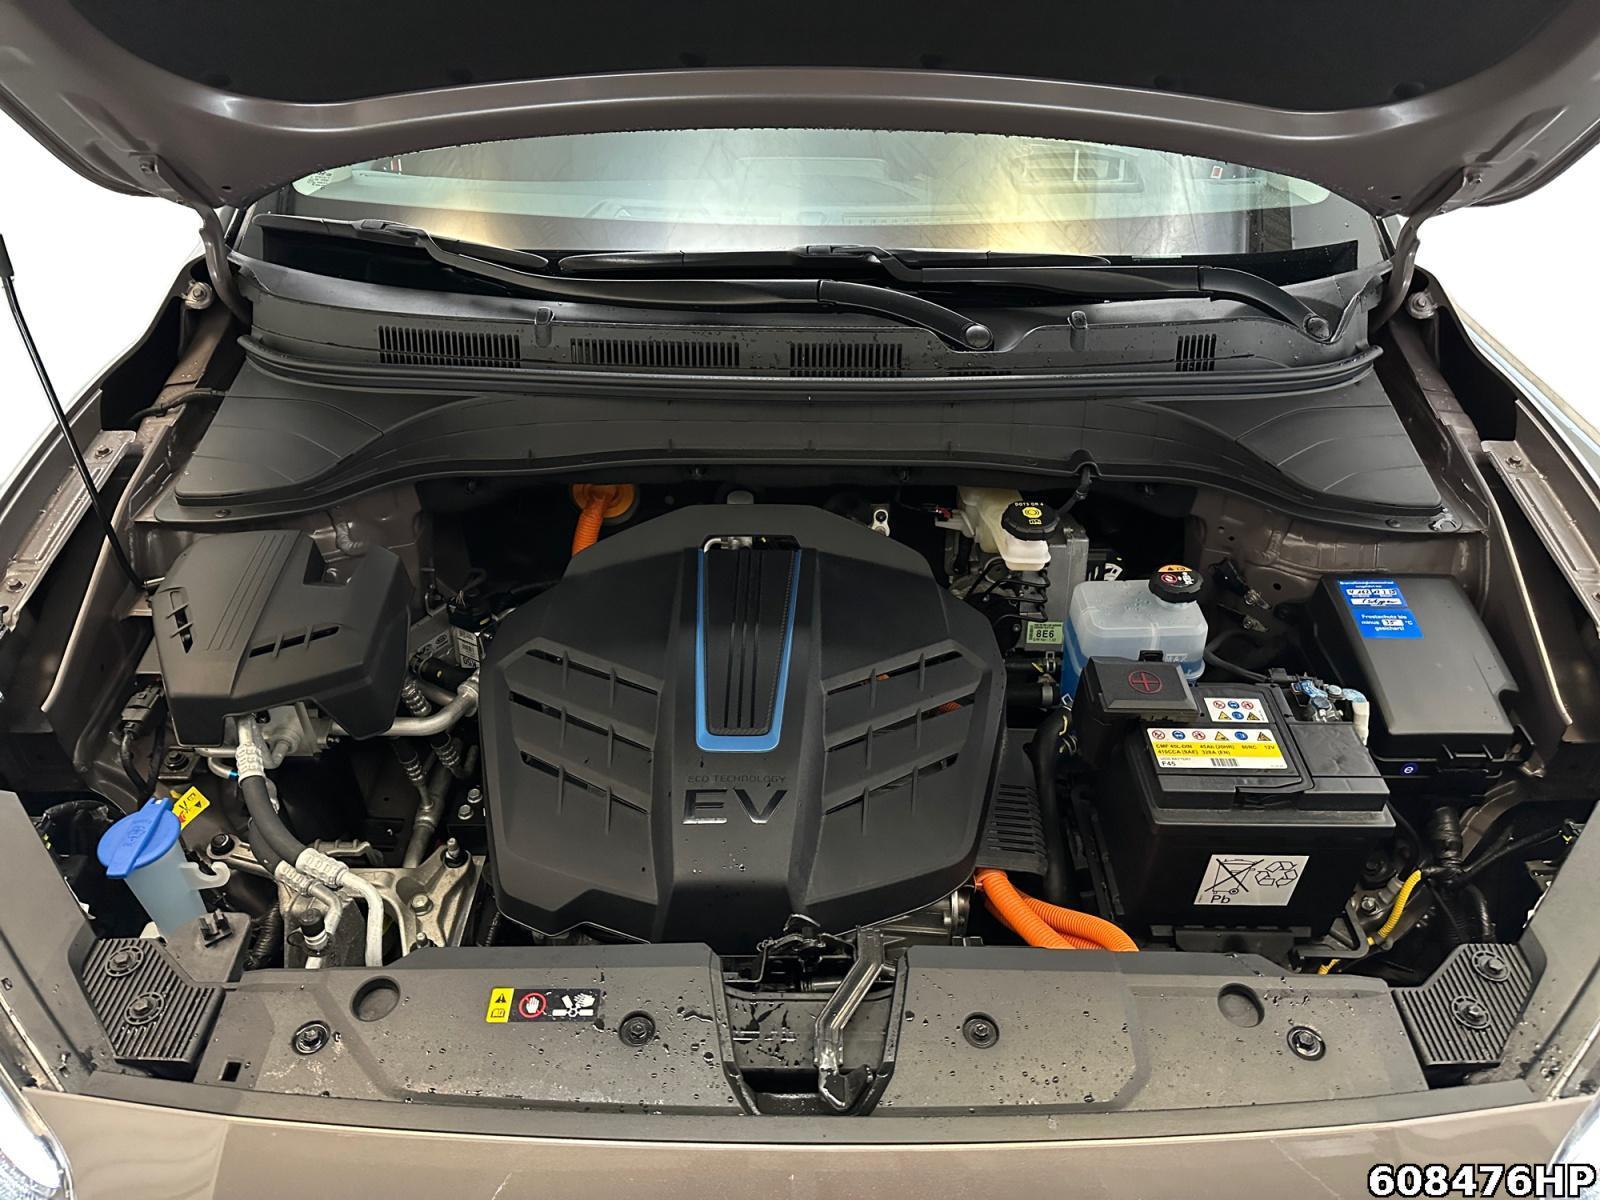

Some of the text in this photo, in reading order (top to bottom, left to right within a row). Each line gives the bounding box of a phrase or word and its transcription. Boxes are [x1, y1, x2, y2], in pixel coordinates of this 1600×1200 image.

[1036, 629, 1055, 639] 8E6
[687, 775, 786, 784] ECO TECHNOLOGY
[682, 788, 788, 824] EV
[1210, 894, 1231, 904] Pb
